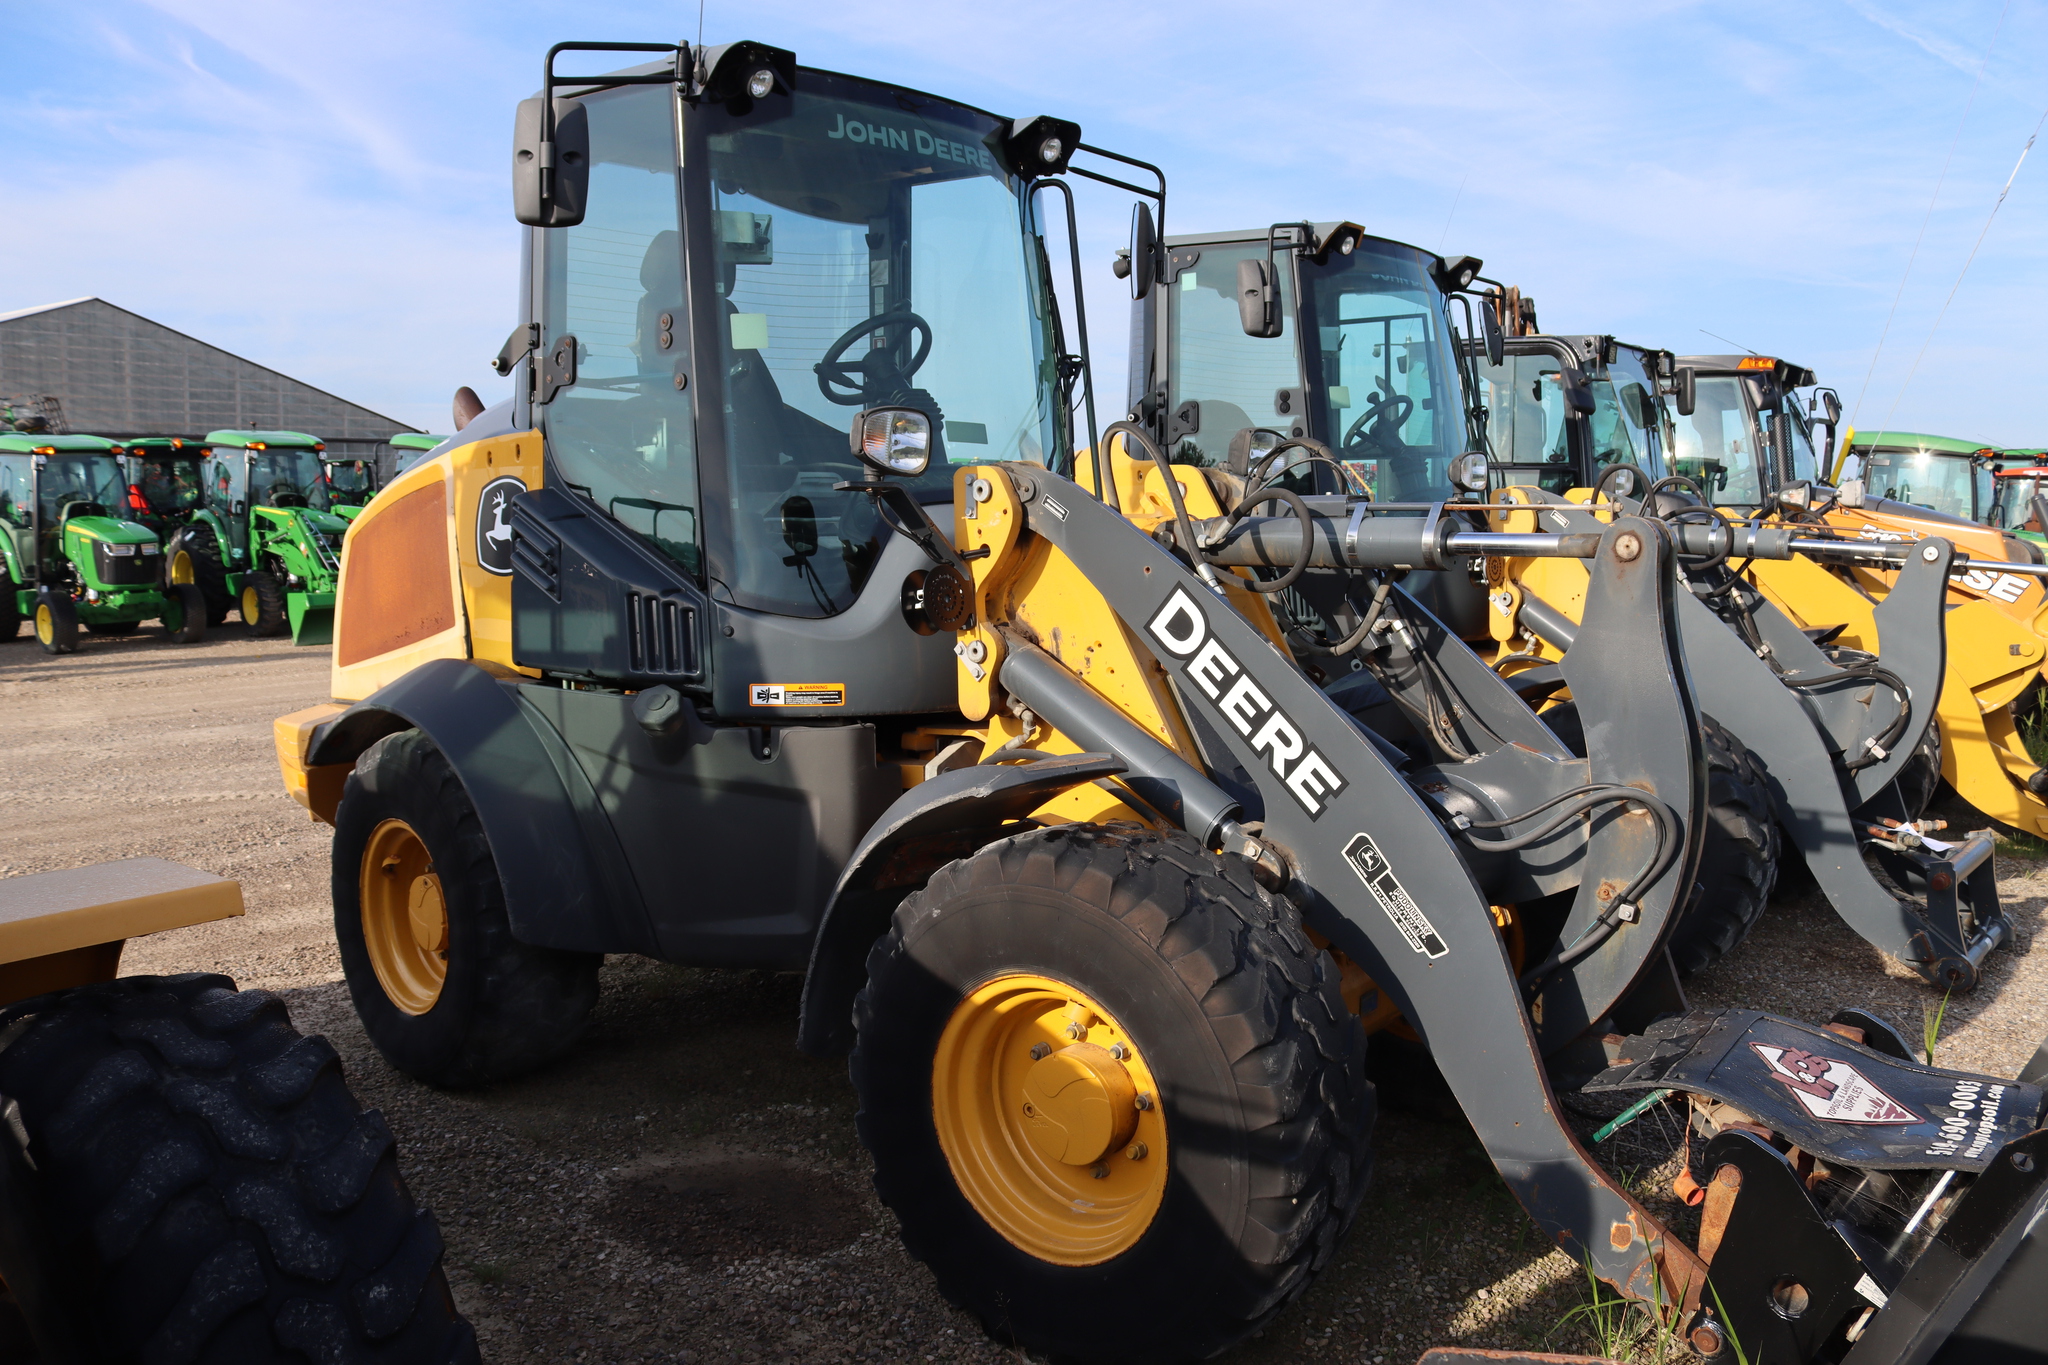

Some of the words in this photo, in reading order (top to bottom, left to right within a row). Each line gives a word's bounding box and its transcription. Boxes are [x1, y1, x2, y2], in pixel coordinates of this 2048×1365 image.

[828, 113, 910, 151] JOHN
[914, 129, 993, 171] DEERE
[1150, 588, 1342, 814] DEERE
[1842, 1085, 1864, 1111] SUPPLIES
